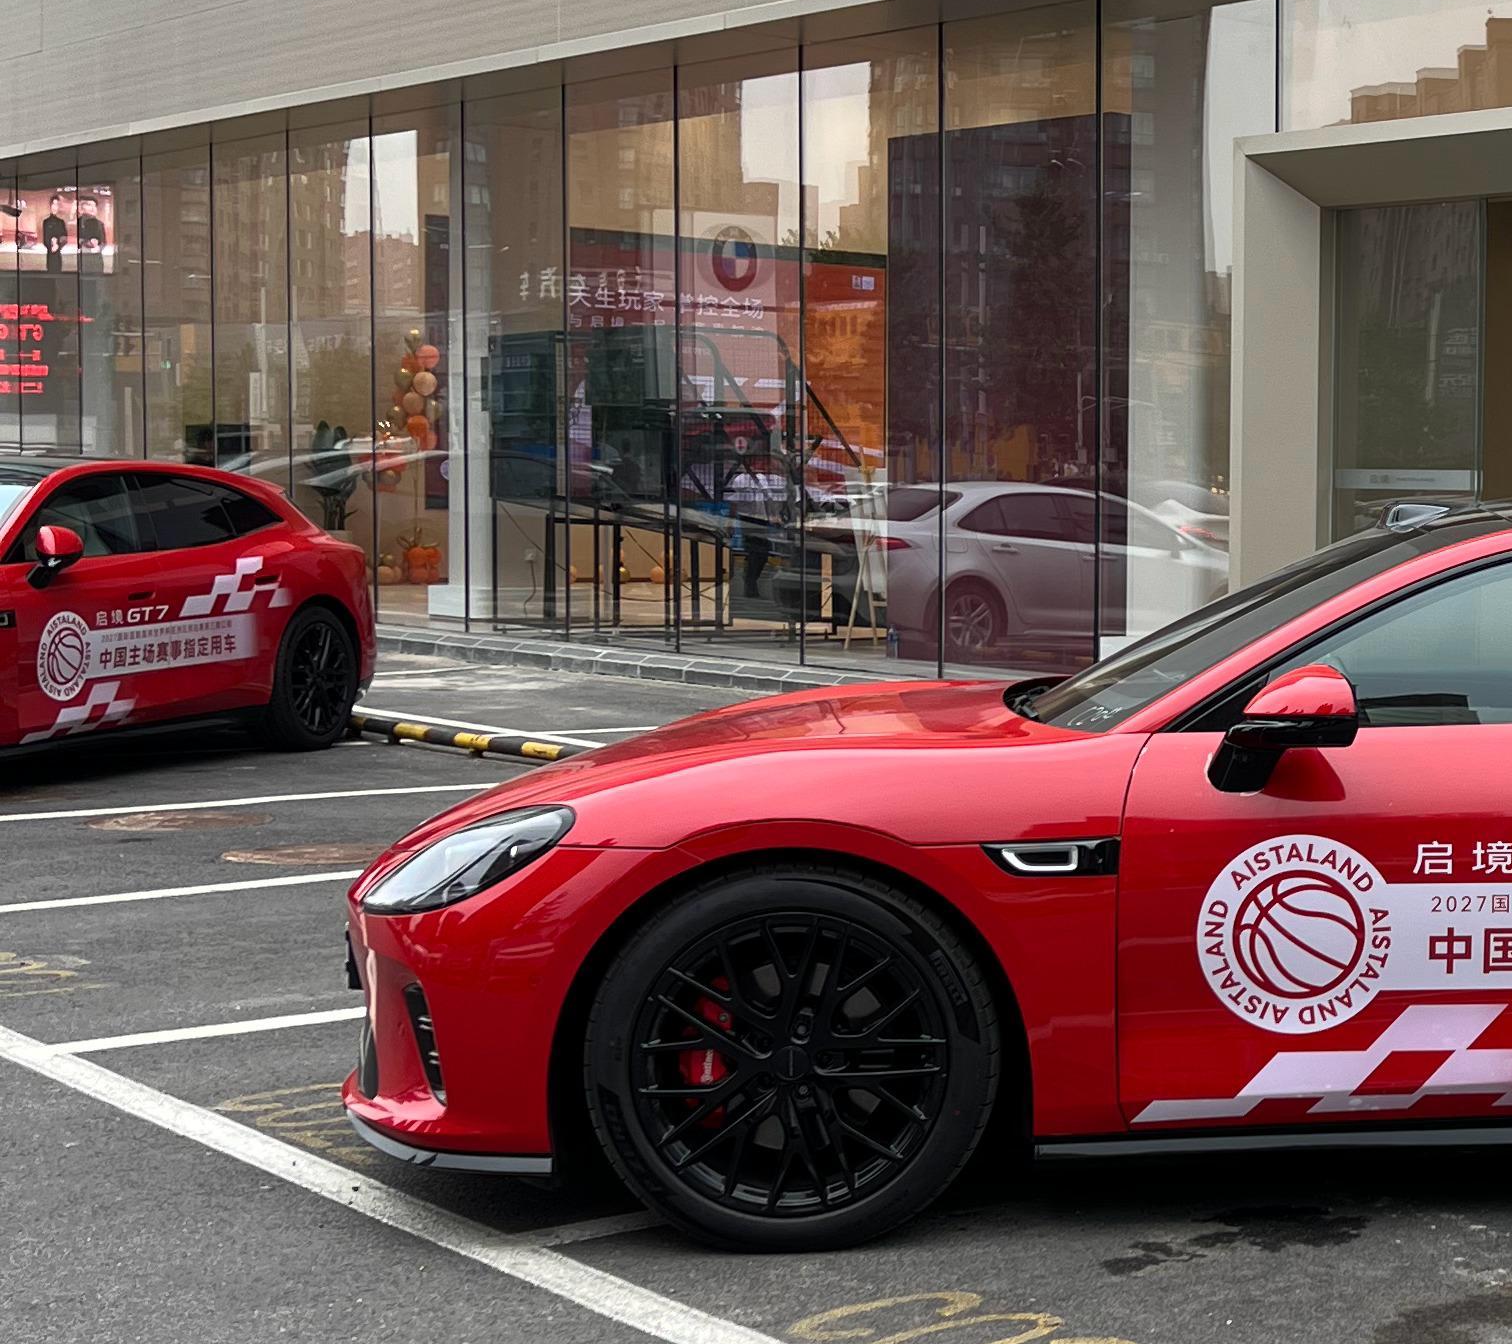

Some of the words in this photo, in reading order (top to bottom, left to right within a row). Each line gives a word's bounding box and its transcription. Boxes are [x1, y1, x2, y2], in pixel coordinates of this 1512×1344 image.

[568, 285, 664, 312] 天生玩家
[96, 609, 124, 626] 启境
[127, 605, 169, 623] GT7
[100, 634, 236, 669] 中国主场赛事指定用车
[1230, 843, 1374, 892] AISTALAND
[1205, 900, 1289, 1024] AISTALAND
[1299, 907, 1391, 1024] AISTALAND
